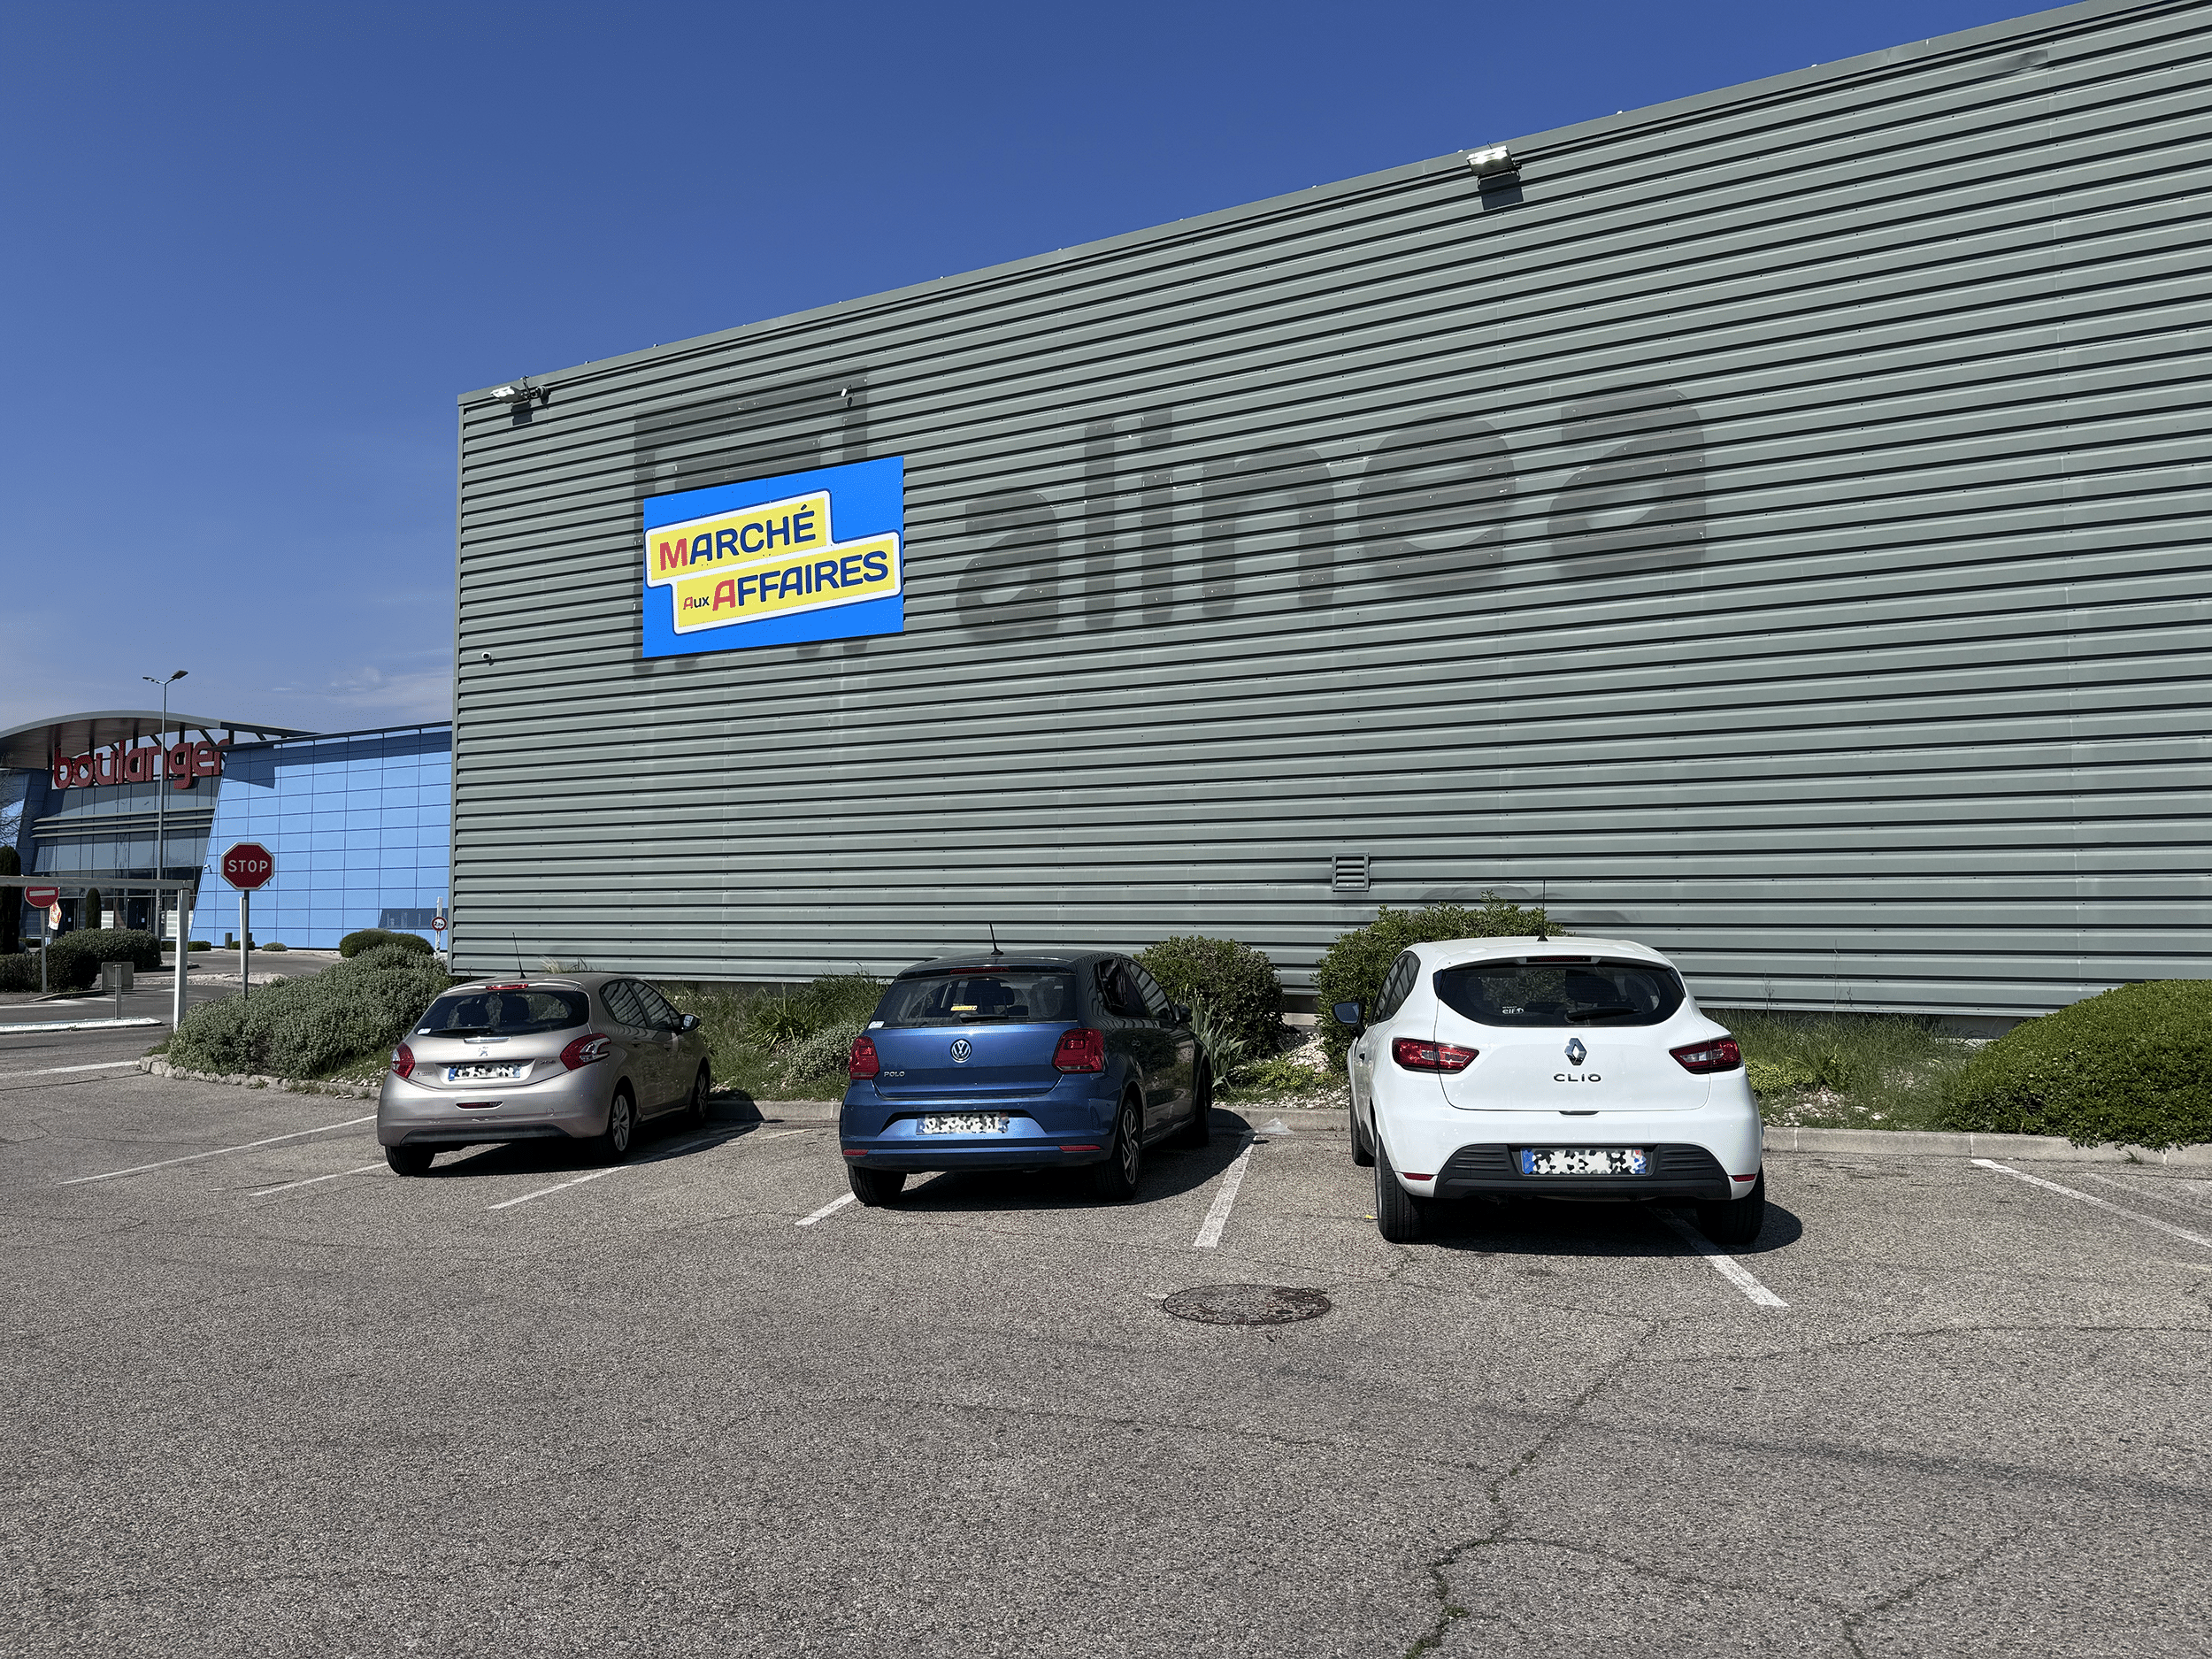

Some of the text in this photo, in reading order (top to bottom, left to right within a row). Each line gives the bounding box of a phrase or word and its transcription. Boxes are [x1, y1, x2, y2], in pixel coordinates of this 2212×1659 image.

[659, 504, 816, 571] MARCHÉ
[955, 380, 1709, 641] alinea
[683, 550, 888, 611] Aux AFFAIRES
[53, 739, 230, 789] boulanger
[227, 859, 268, 873] STOP
[1553, 1073, 1601, 1082] CLIO
